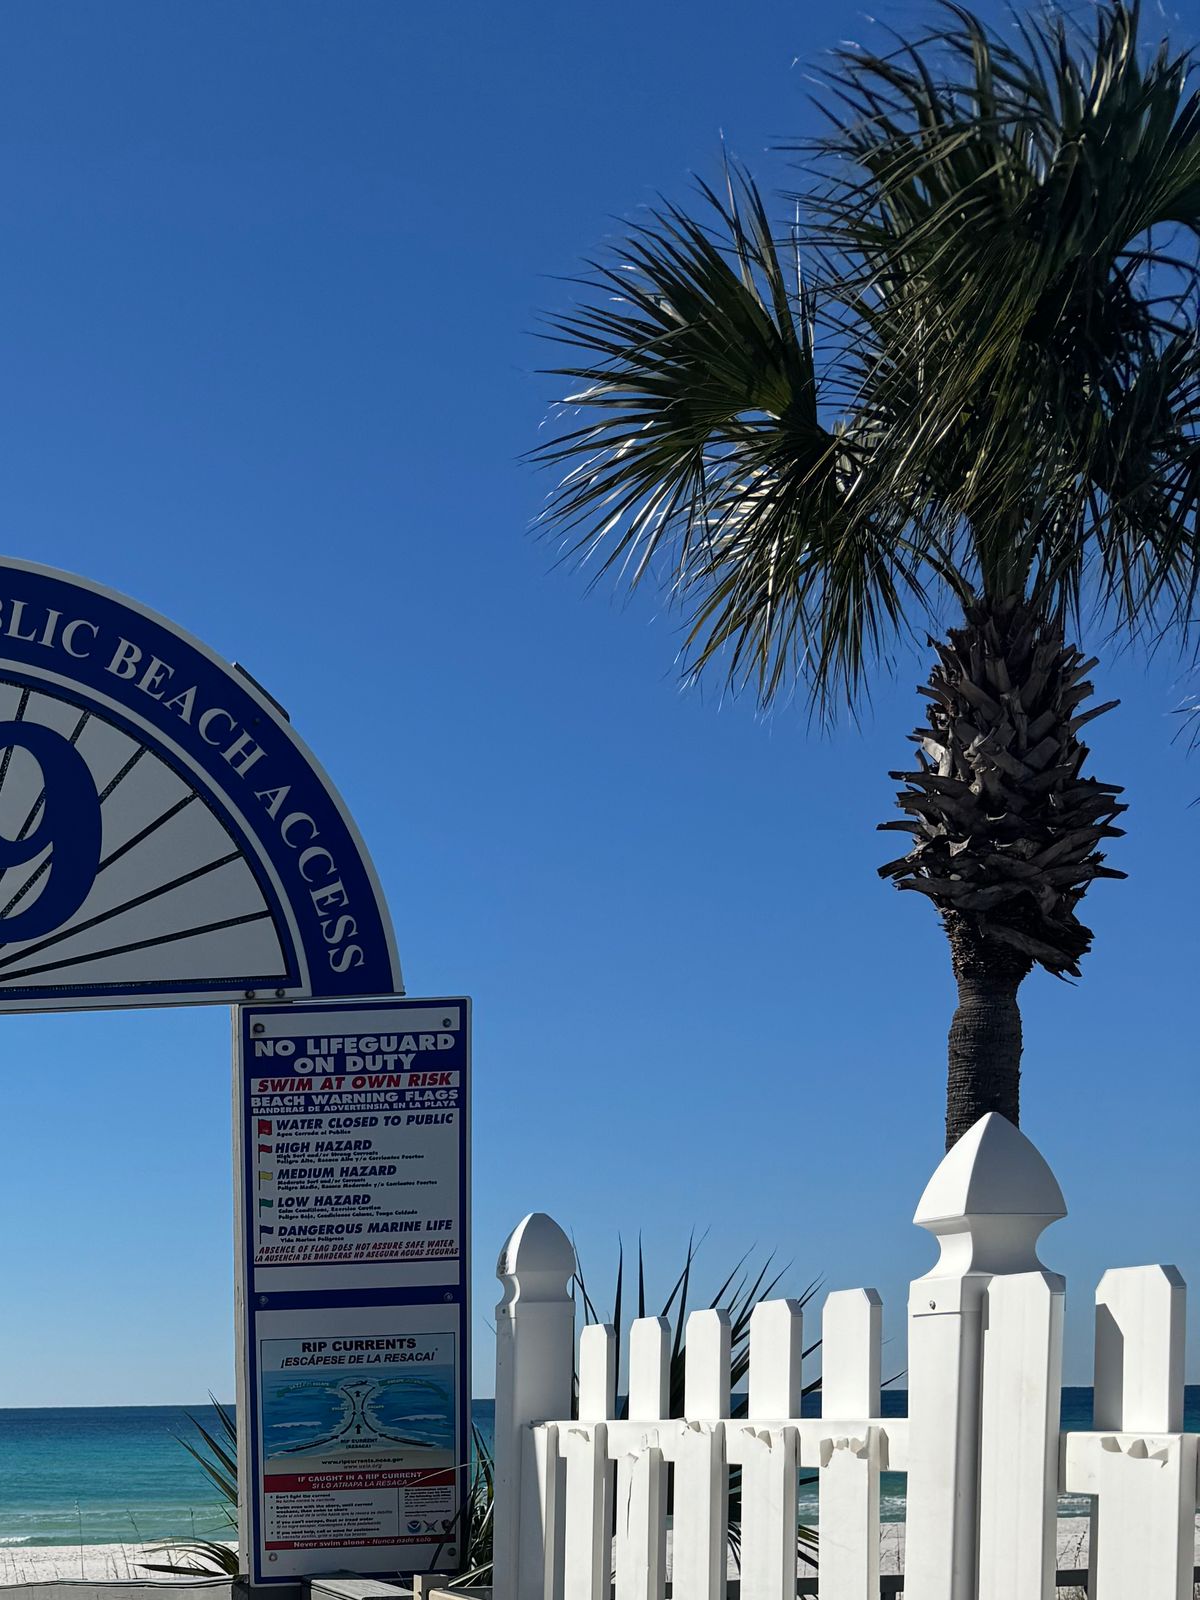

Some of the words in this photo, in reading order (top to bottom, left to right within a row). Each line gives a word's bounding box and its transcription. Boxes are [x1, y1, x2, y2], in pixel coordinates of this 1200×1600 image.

[104, 636, 268, 780] BEACH
[253, 784, 365, 974] ACCESS
[255, 1039, 296, 1057] NO
[306, 1034, 455, 1055] LIFEGUARD
[293, 1056, 335, 1074] ON
[346, 1054, 416, 1072] DUTY
[257, 1078, 313, 1093] SWIM
[319, 1076, 346, 1091] AT
[351, 1074, 402, 1090] OWN
[407, 1073, 453, 1087] RISK
[250, 1096, 305, 1108] BEACH
[311, 1093, 399, 1105] WARNING
[405, 1090, 459, 1101] FLAGS
[276, 1118, 324, 1131] WATER
[327, 1116, 379, 1129] CLOSED
[383, 1115, 402, 1127] TO
[406, 1113, 454, 1126] PUBLIC
[274, 1142, 311, 1154] HIGH
[314, 1140, 372, 1153] HAZARD
[277, 1167, 335, 1180] MEDIUM
[339, 1165, 397, 1178] HAZARD
[277, 1197, 310, 1208] LOW
[313, 1195, 372, 1207] HAZARD
[278, 1223, 363, 1238] DANGEROUS
[367, 1221, 422, 1234] MARINE
[426, 1220, 453, 1232] LIFE
[301, 1341, 328, 1353] RIP
[331, 1338, 417, 1352] CURRENTS
[348, 1354, 365, 1365] DE
[366, 1354, 382, 1364] LA
[308, 1475, 343, 1483] CAUGHT
[365, 1473, 380, 1481] RIP
[381, 1472, 422, 1480] CURRENT
[312, 1482, 320, 1490] SI
[375, 1479, 408, 1488] RESACA
